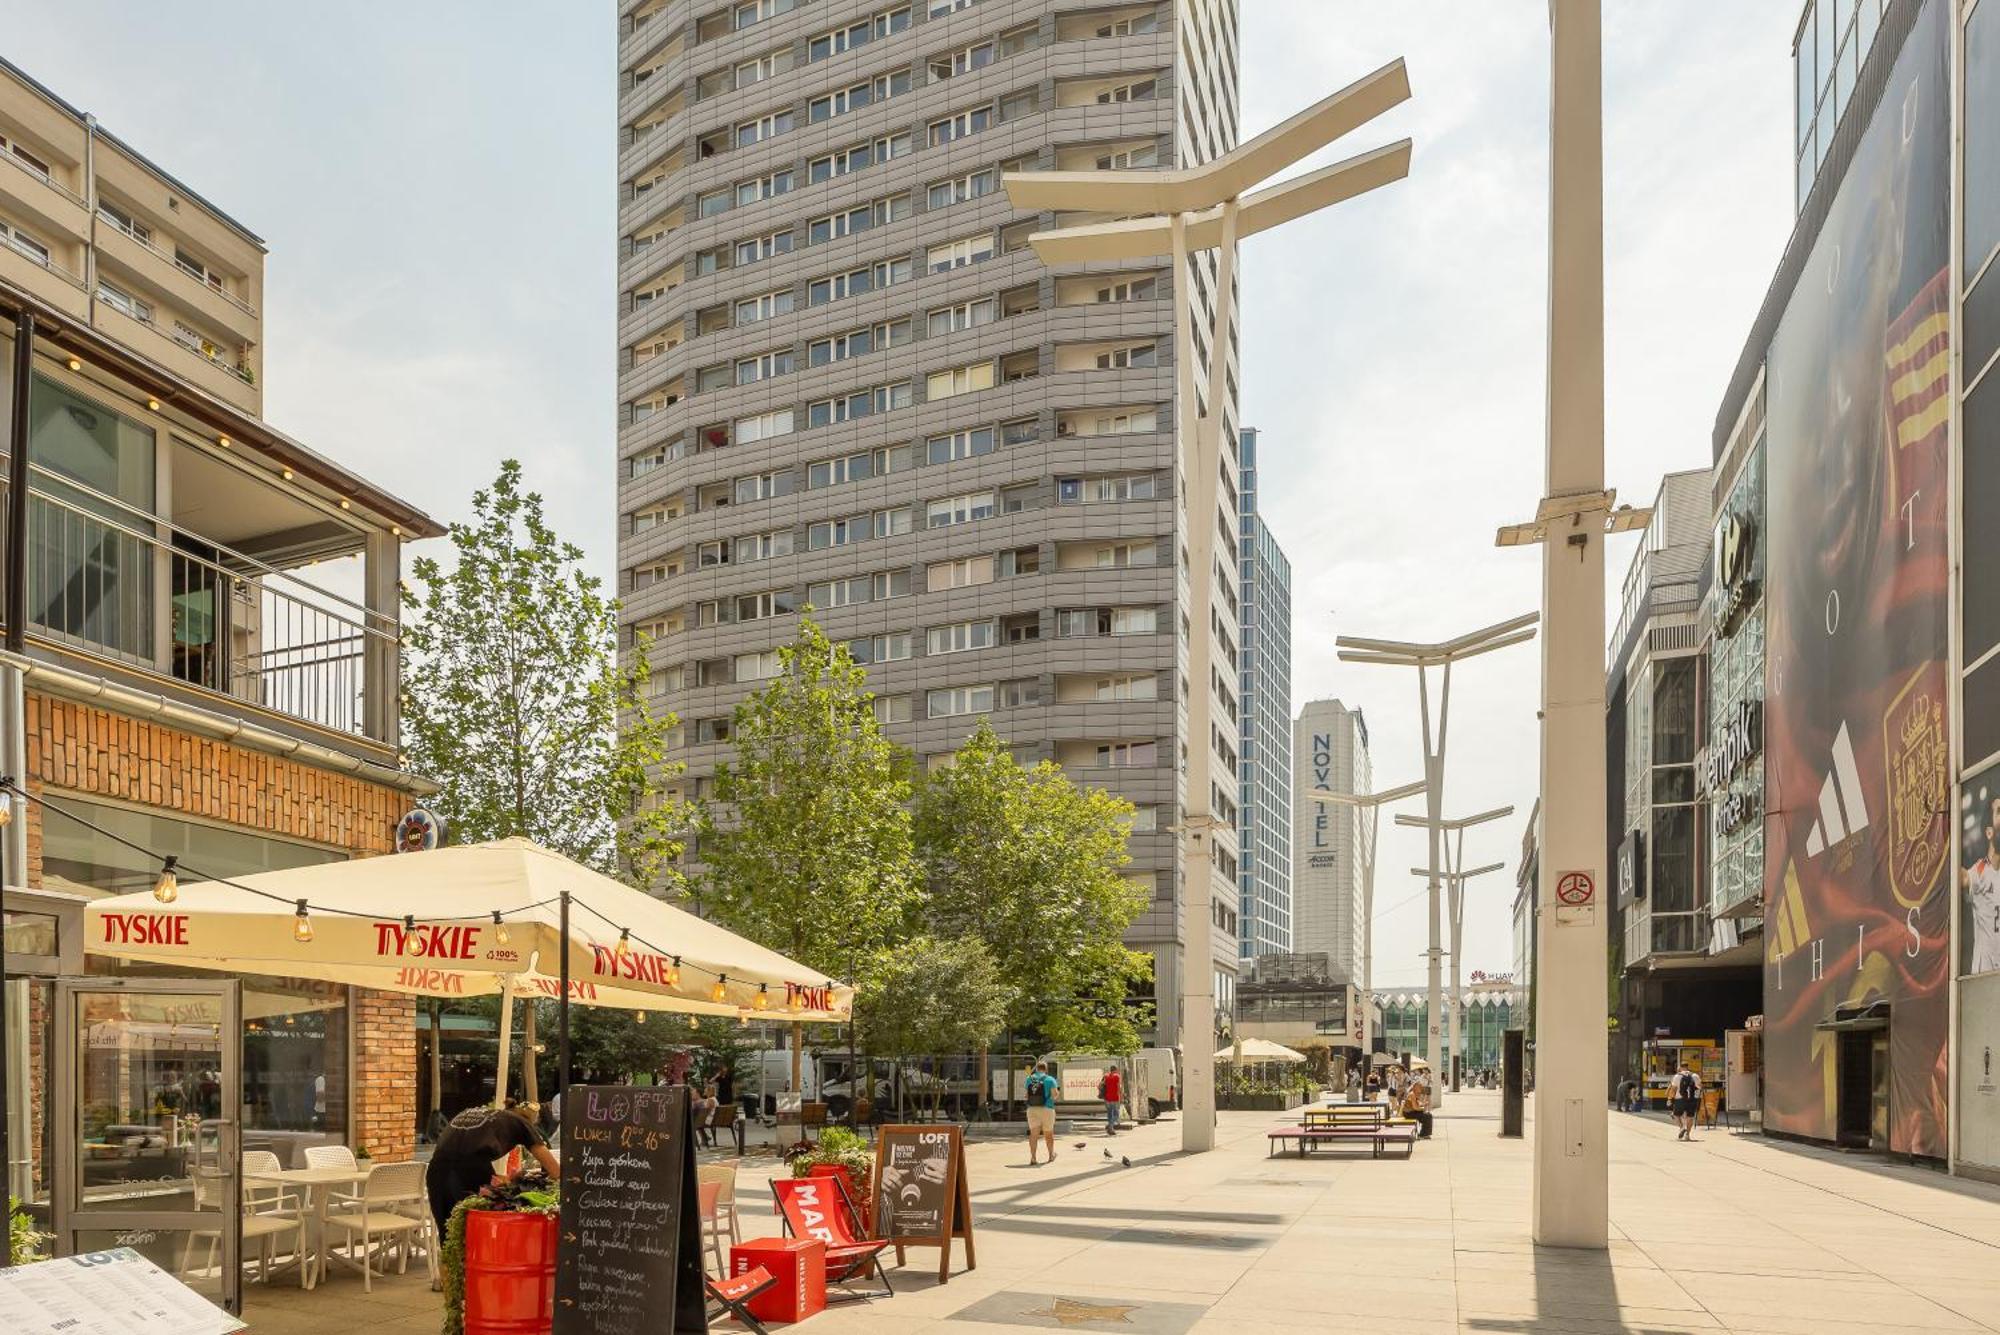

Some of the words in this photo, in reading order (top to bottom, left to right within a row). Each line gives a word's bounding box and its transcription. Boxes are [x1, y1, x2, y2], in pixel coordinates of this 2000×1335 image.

[101, 914, 189, 945] TYSKIE
[373, 923, 482, 960] TYSKIE
[588, 942, 673, 985] TYSKIE
[587, 1091, 674, 1124] LOFT
[574, 1125, 612, 1142] LUNCH
[919, 1132, 950, 1144] LOFT
